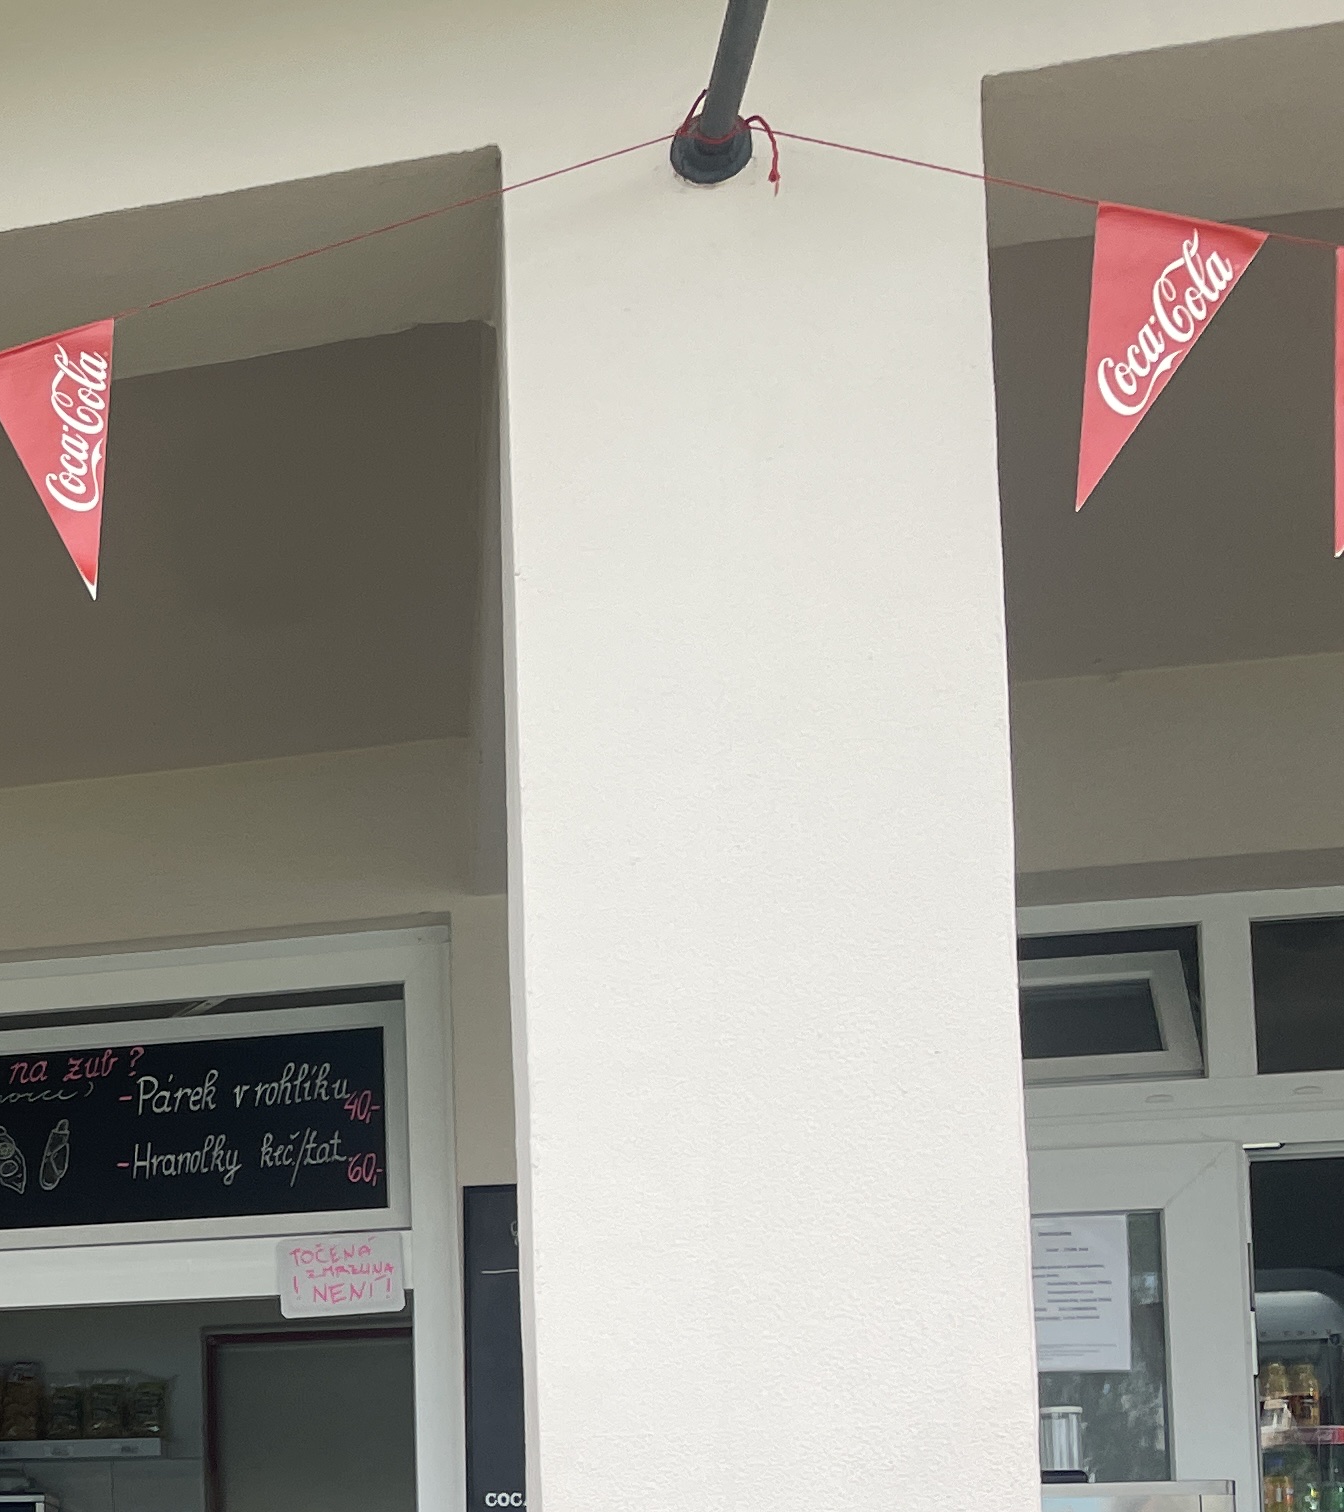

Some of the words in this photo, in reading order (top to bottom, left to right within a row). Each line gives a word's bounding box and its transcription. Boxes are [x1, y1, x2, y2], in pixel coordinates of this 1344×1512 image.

[1097, 230, 1234, 416] Coca-Cola
[45, 343, 108, 512] Coca-Cola
[9, 1060, 49, 1085] na
[137, 1069, 220, 1116] Párek
[132, 1134, 242, 1186] Hranolky
[485, 1491, 527, 1507] COC
